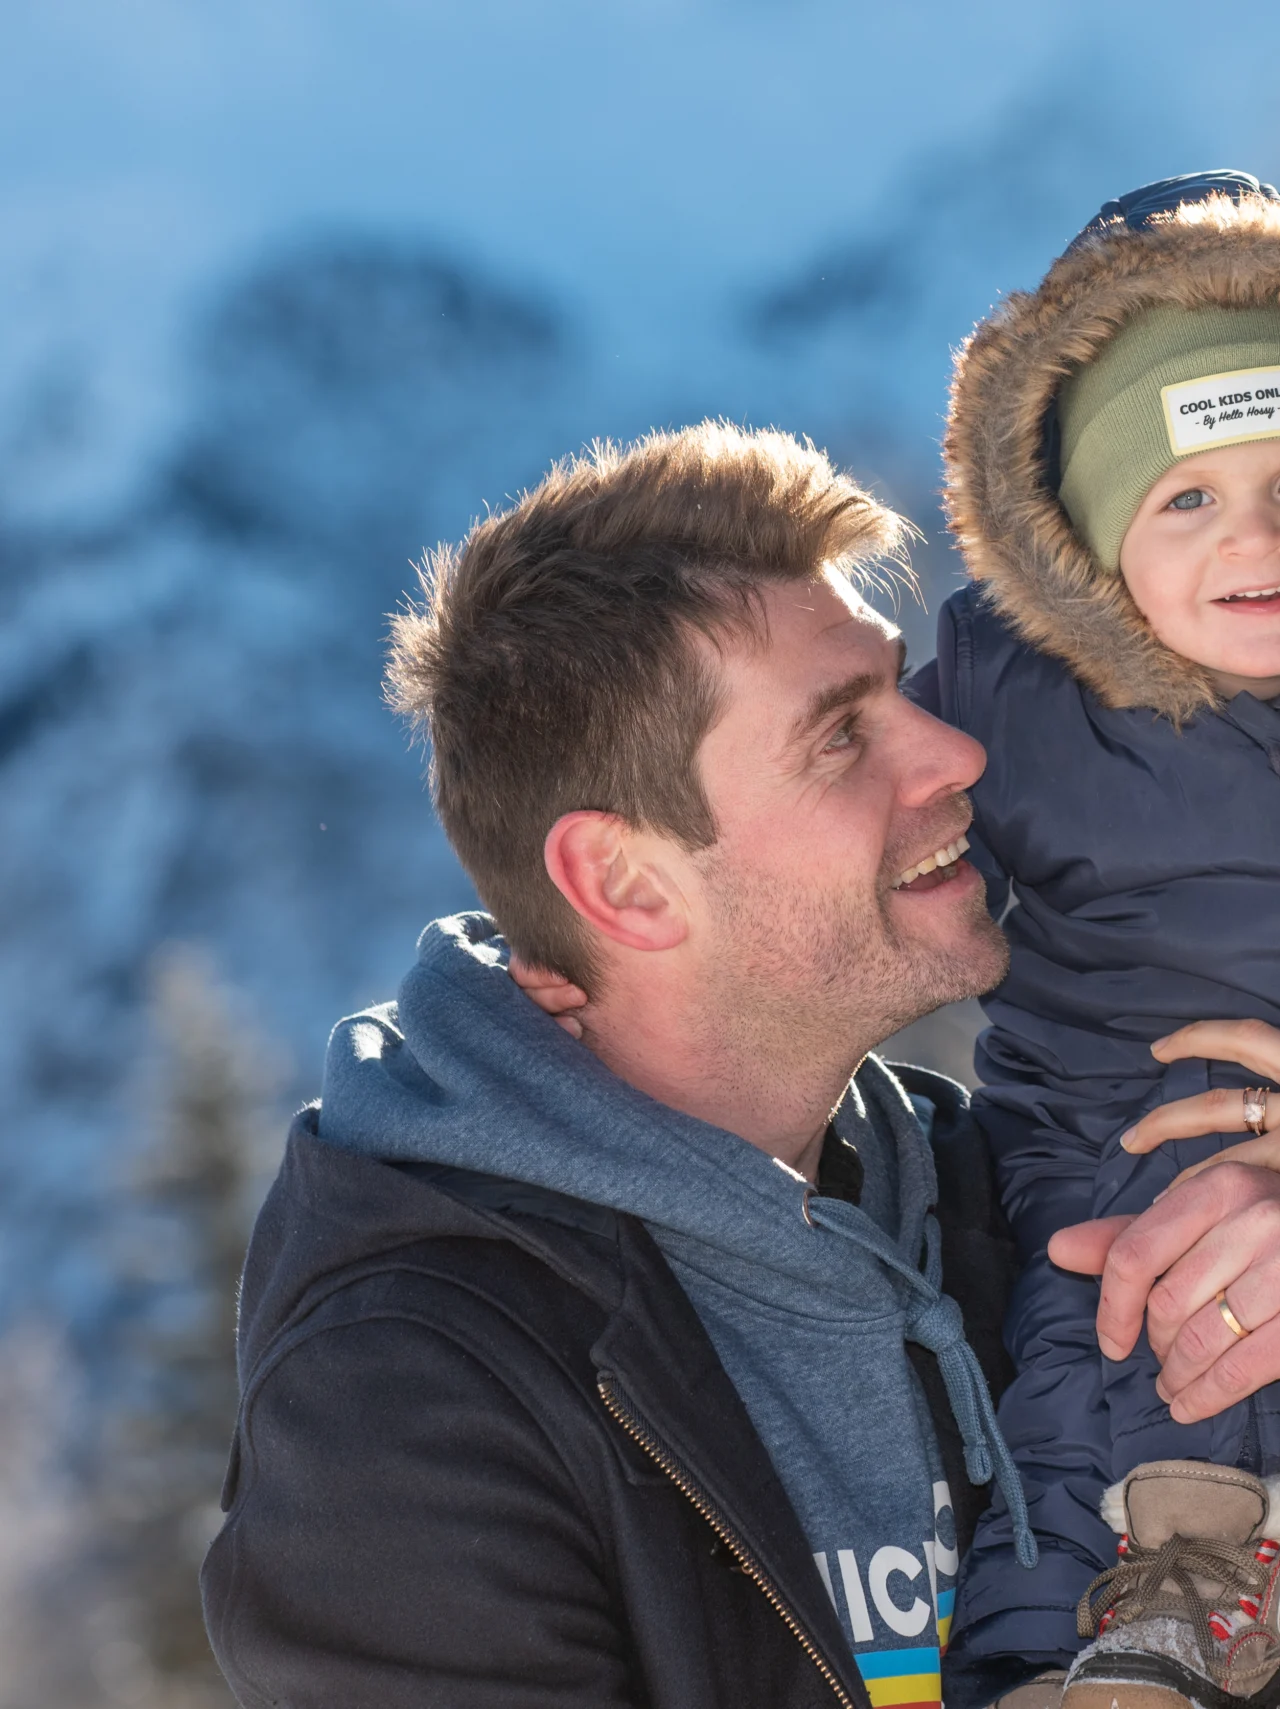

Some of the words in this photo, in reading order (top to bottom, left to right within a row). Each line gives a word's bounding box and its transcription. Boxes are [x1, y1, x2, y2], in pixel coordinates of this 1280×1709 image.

[1179, 399, 1216, 415] COOL
[1218, 391, 1252, 407] KIDS
[1203, 414, 1216, 430] By
[1218, 409, 1244, 422] Hello
[1246, 406, 1275, 419] Hossy
